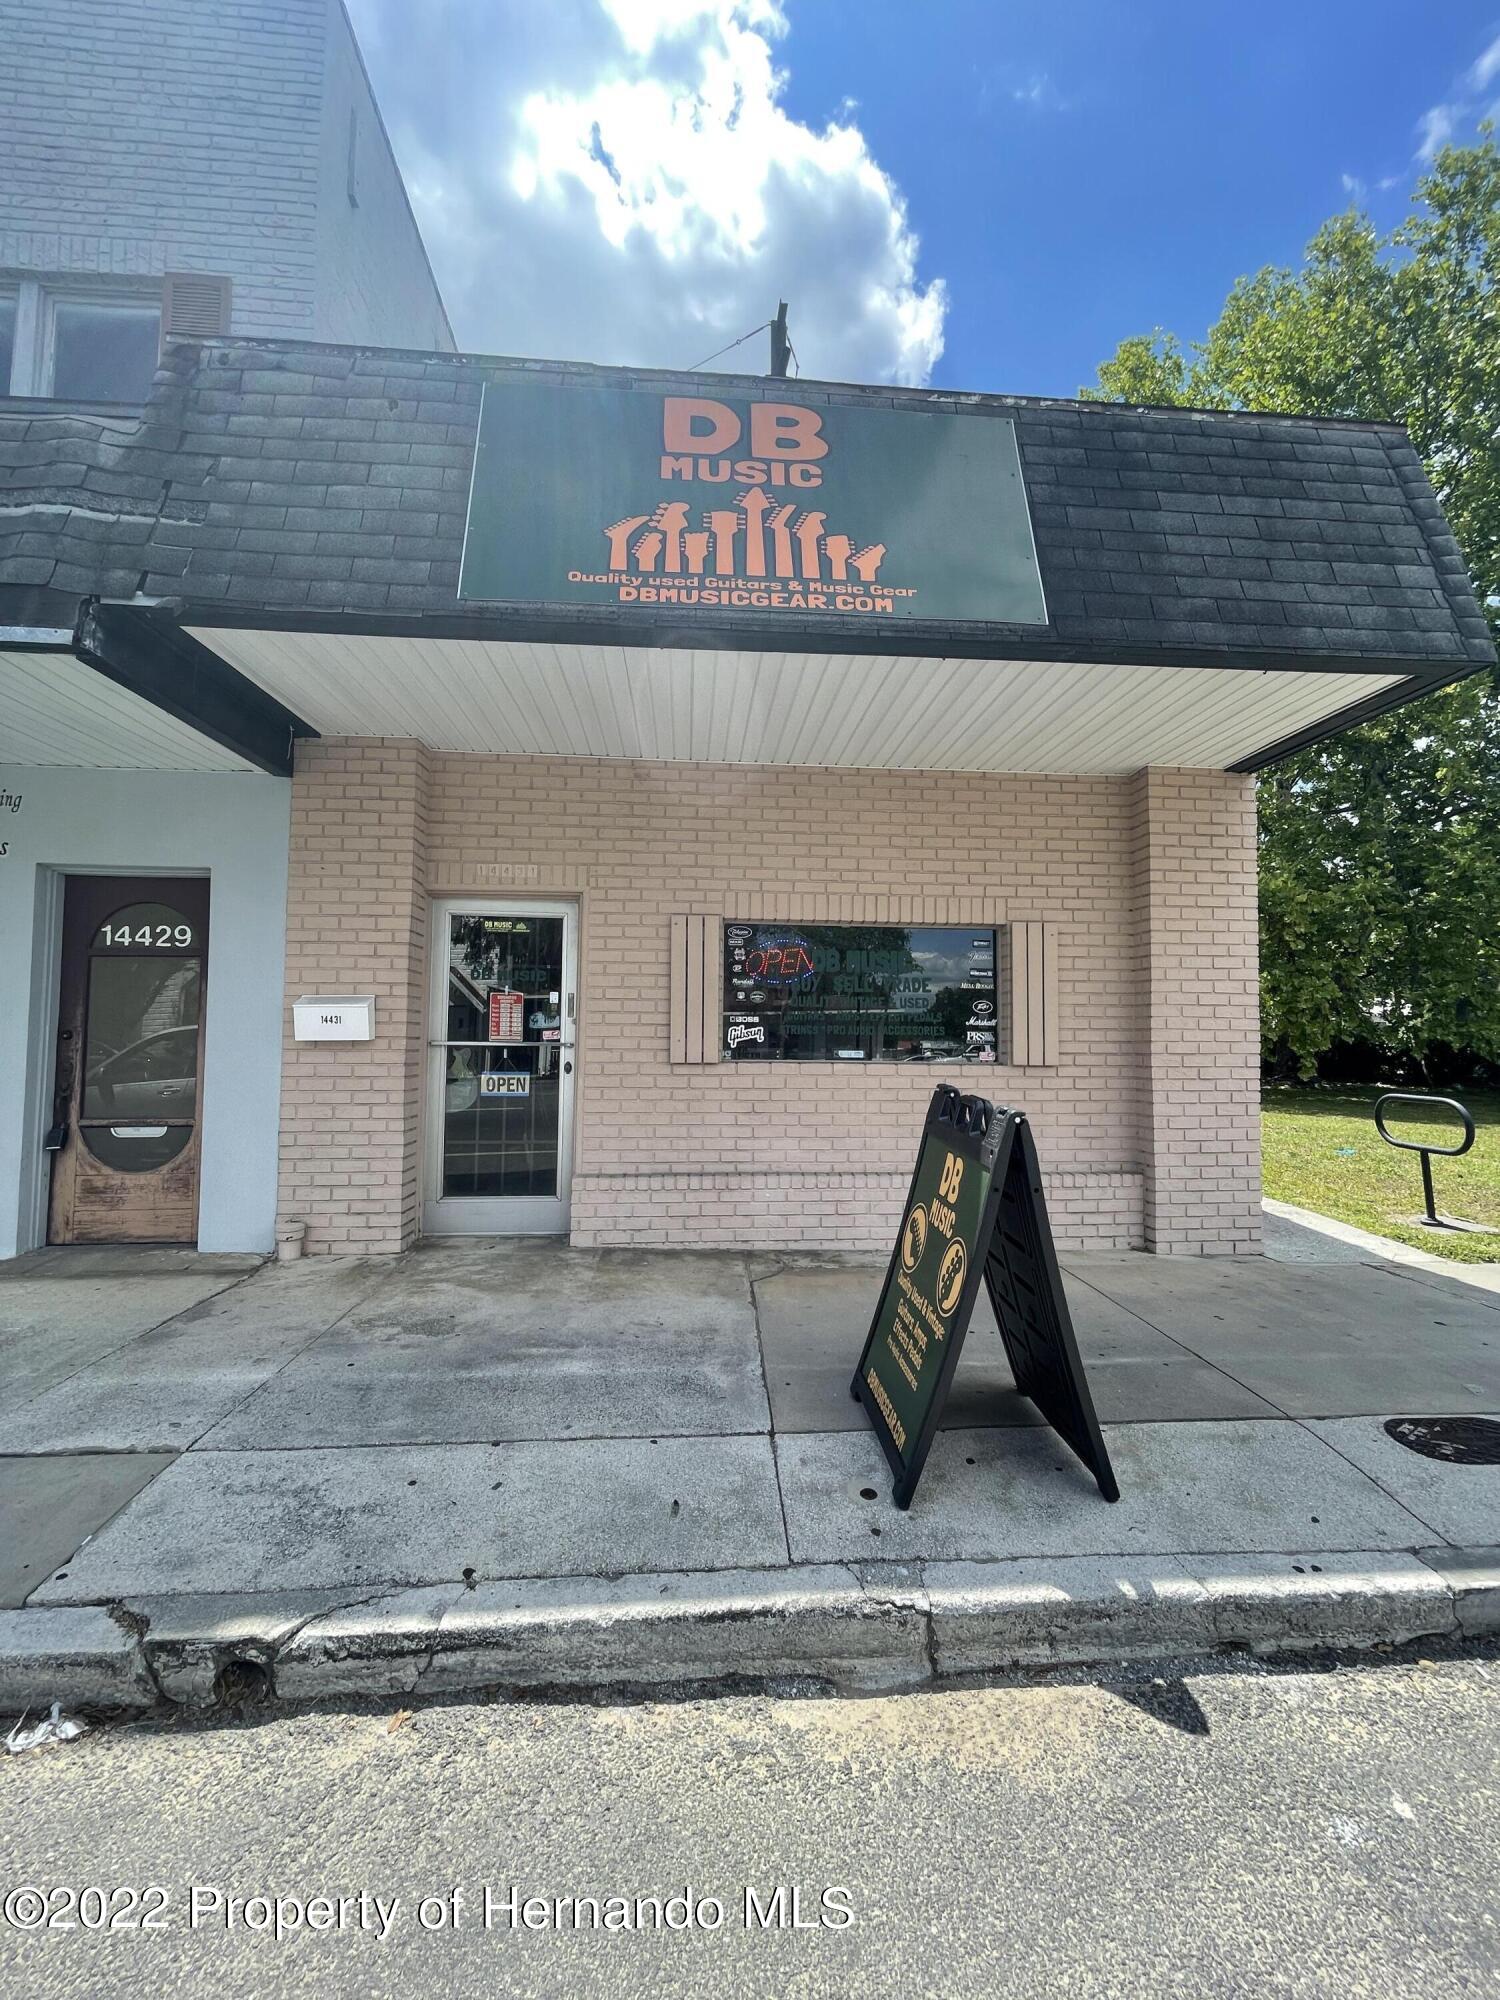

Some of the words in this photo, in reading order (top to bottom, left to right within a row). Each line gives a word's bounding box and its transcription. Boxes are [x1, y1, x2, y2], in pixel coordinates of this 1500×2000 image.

[663, 397, 829, 461] DB
[660, 456, 823, 488] MUSIC
[567, 571, 643, 587] Quality
[648, 577, 699, 587] used
[705, 577, 782, 590] Guitars
[788, 580, 803, 591] &
[809, 581, 864, 594] Music
[869, 584, 918, 597] Gear
[619, 586, 893, 612] DBMUSICGEAR.COM
[101, 925, 192, 947] 14429
[746, 948, 814, 976] OPEN
[320, 1015, 342, 1025] 14431
[728, 1025, 764, 1048] Gibson
[967, 1031, 985, 1041] PRS
[486, 1076, 526, 1093] OPEN
[939, 1152, 963, 1204] DB
[929, 1198, 955, 1239] MUSIC
[911, 1286, 924, 1310] Used
